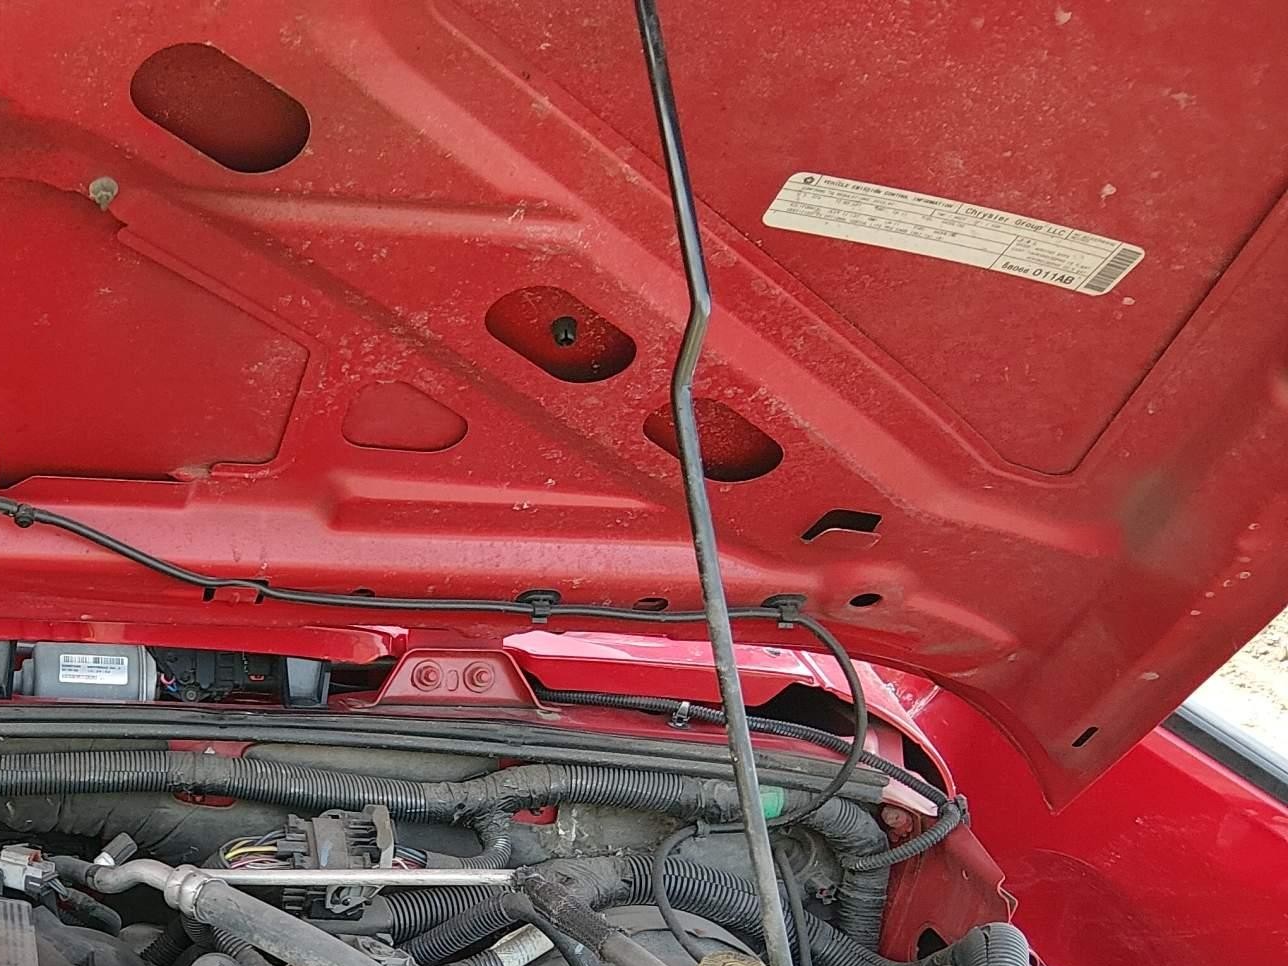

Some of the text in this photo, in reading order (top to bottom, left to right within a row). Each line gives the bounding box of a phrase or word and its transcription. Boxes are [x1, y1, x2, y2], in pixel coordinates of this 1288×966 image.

[965, 207, 1066, 236] Chrysler Group LLC
[1032, 268, 1075, 285] 011AB
